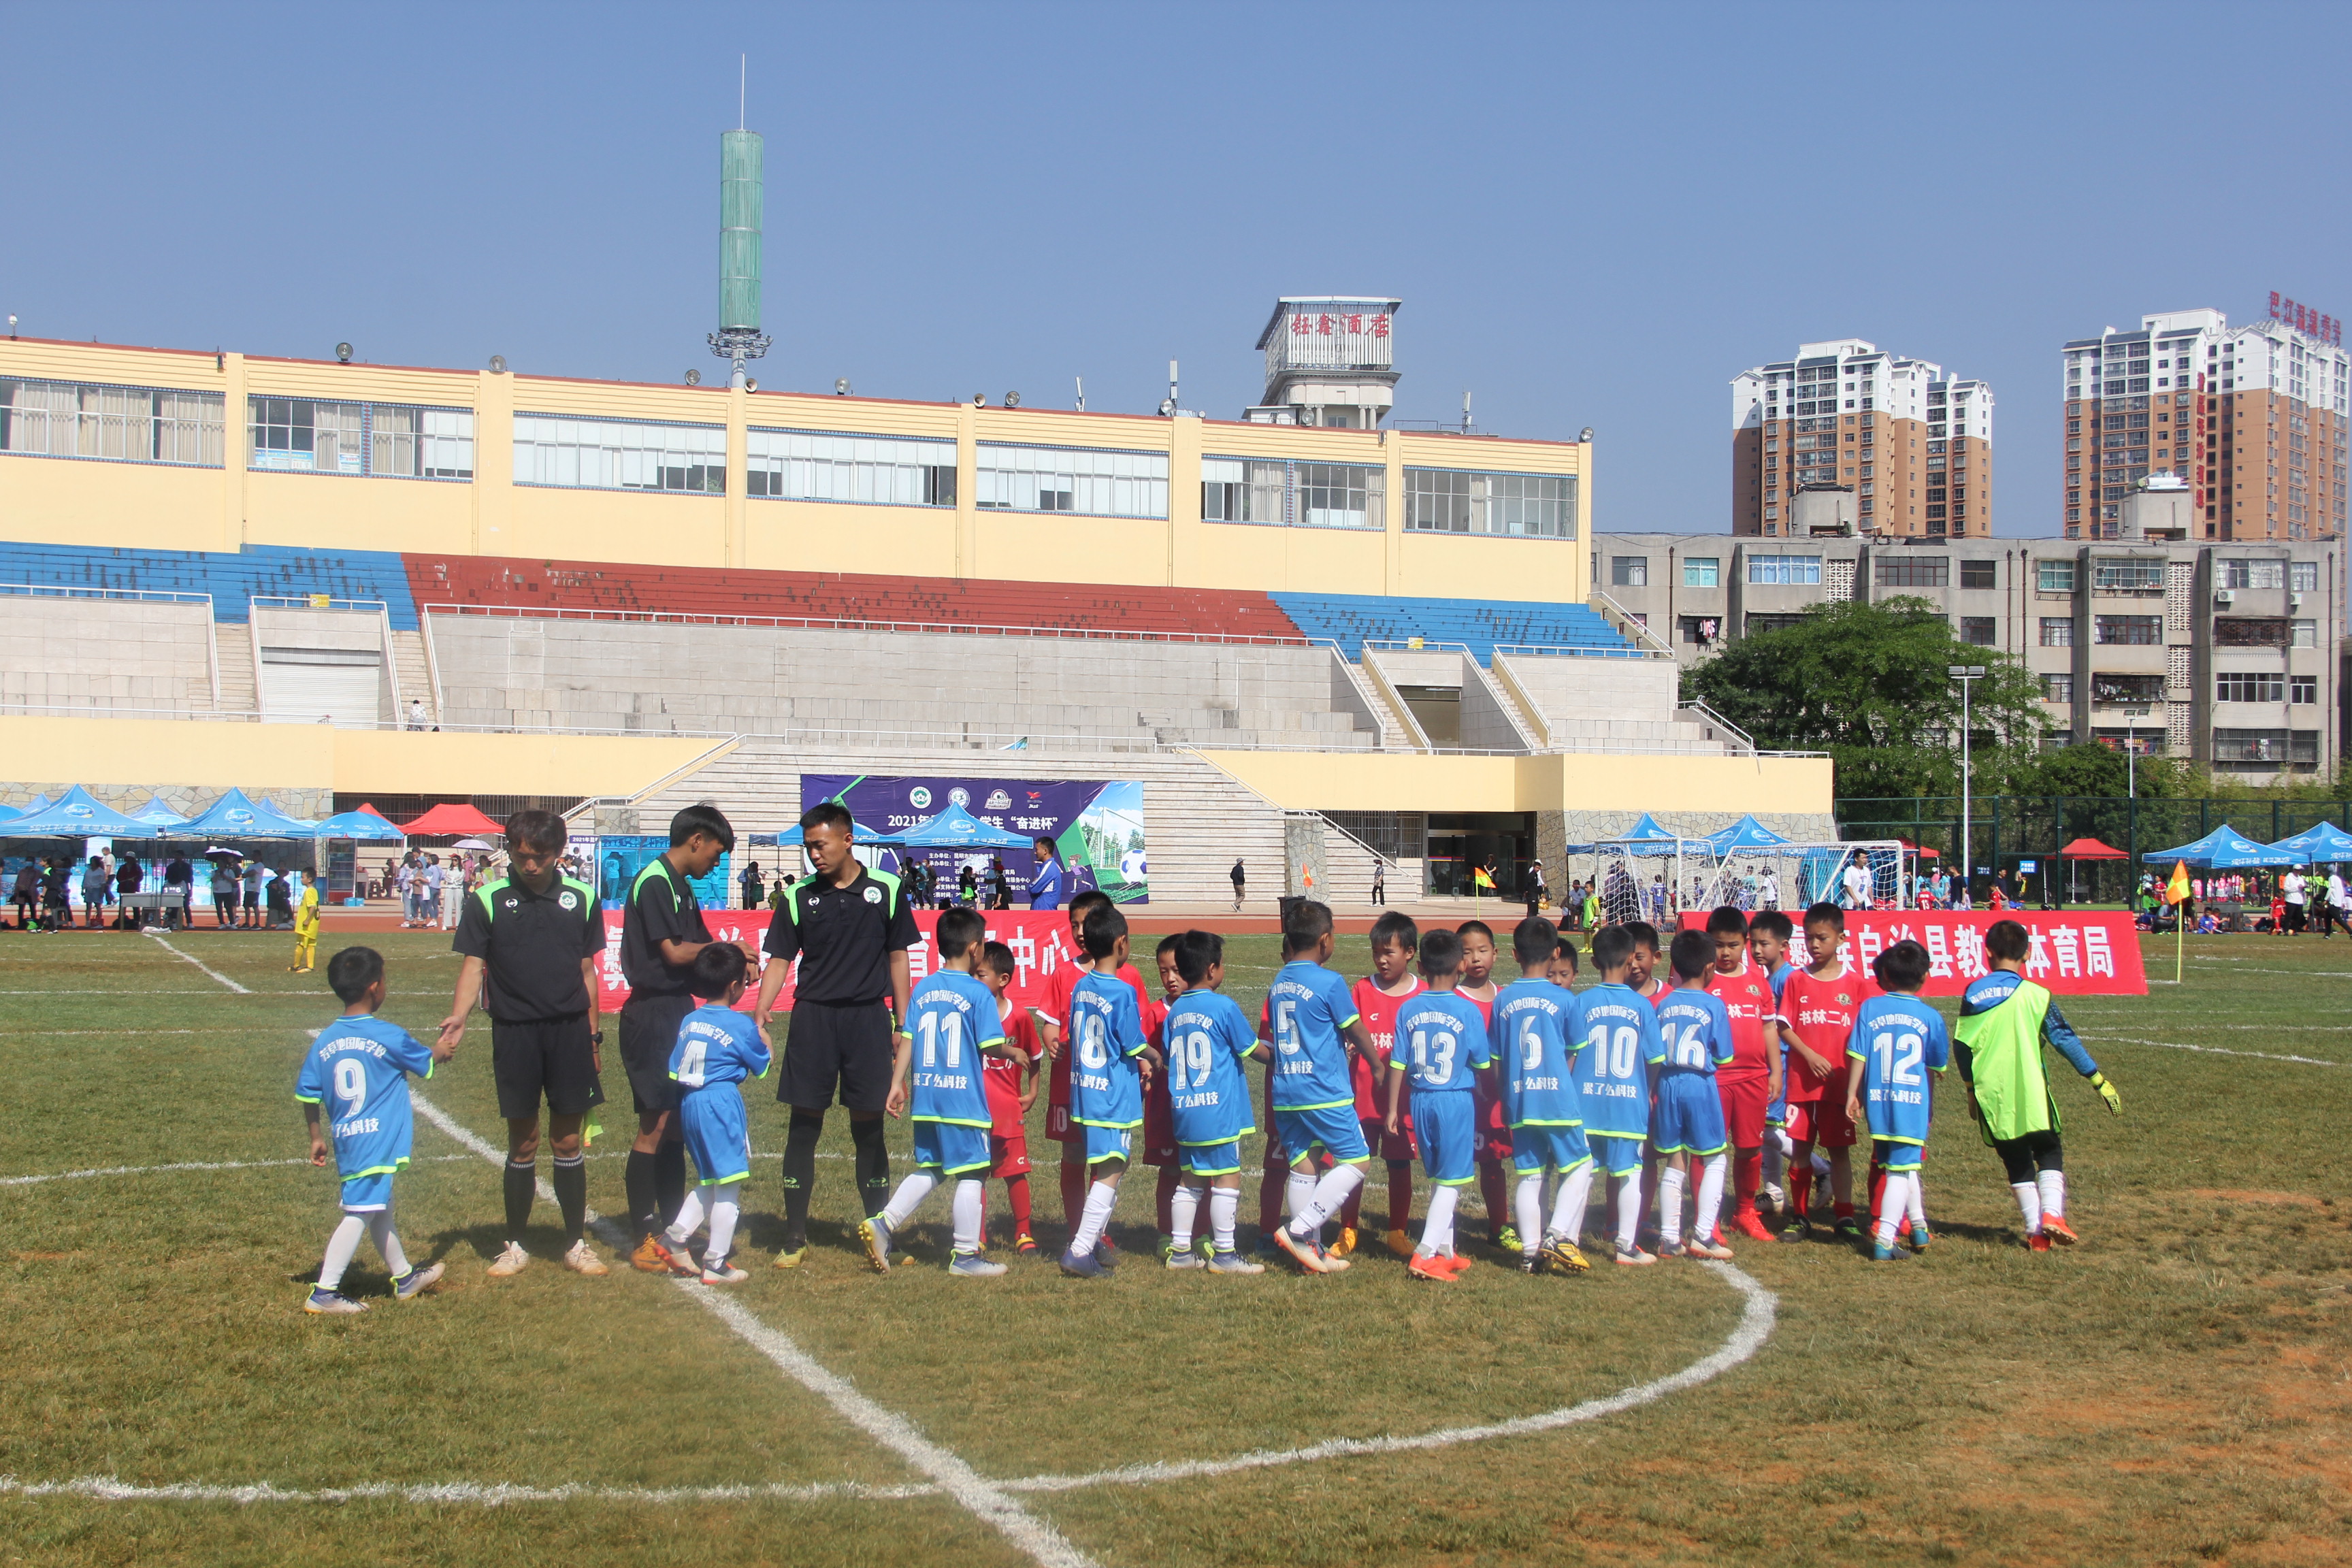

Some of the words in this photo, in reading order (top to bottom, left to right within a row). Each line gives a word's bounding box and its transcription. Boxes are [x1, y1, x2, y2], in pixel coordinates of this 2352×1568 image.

[918, 1011, 962, 1068] 11
[1072, 1010, 1107, 1070] 18
[1277, 1000, 1301, 1055] 5
[1519, 1015, 1541, 1071] 6
[1799, 1009, 1851, 1027] 书林二小
[678, 1039, 708, 1088] 4
[1169, 1031, 1212, 1090] 19
[1411, 1030, 1456, 1085] 13
[1588, 1024, 1638, 1079] 10
[1661, 1022, 1706, 1070] 16
[1874, 1032, 1923, 1085] 12
[334, 1058, 367, 1118] 9
[1785, 1104, 1799, 1128] 9
